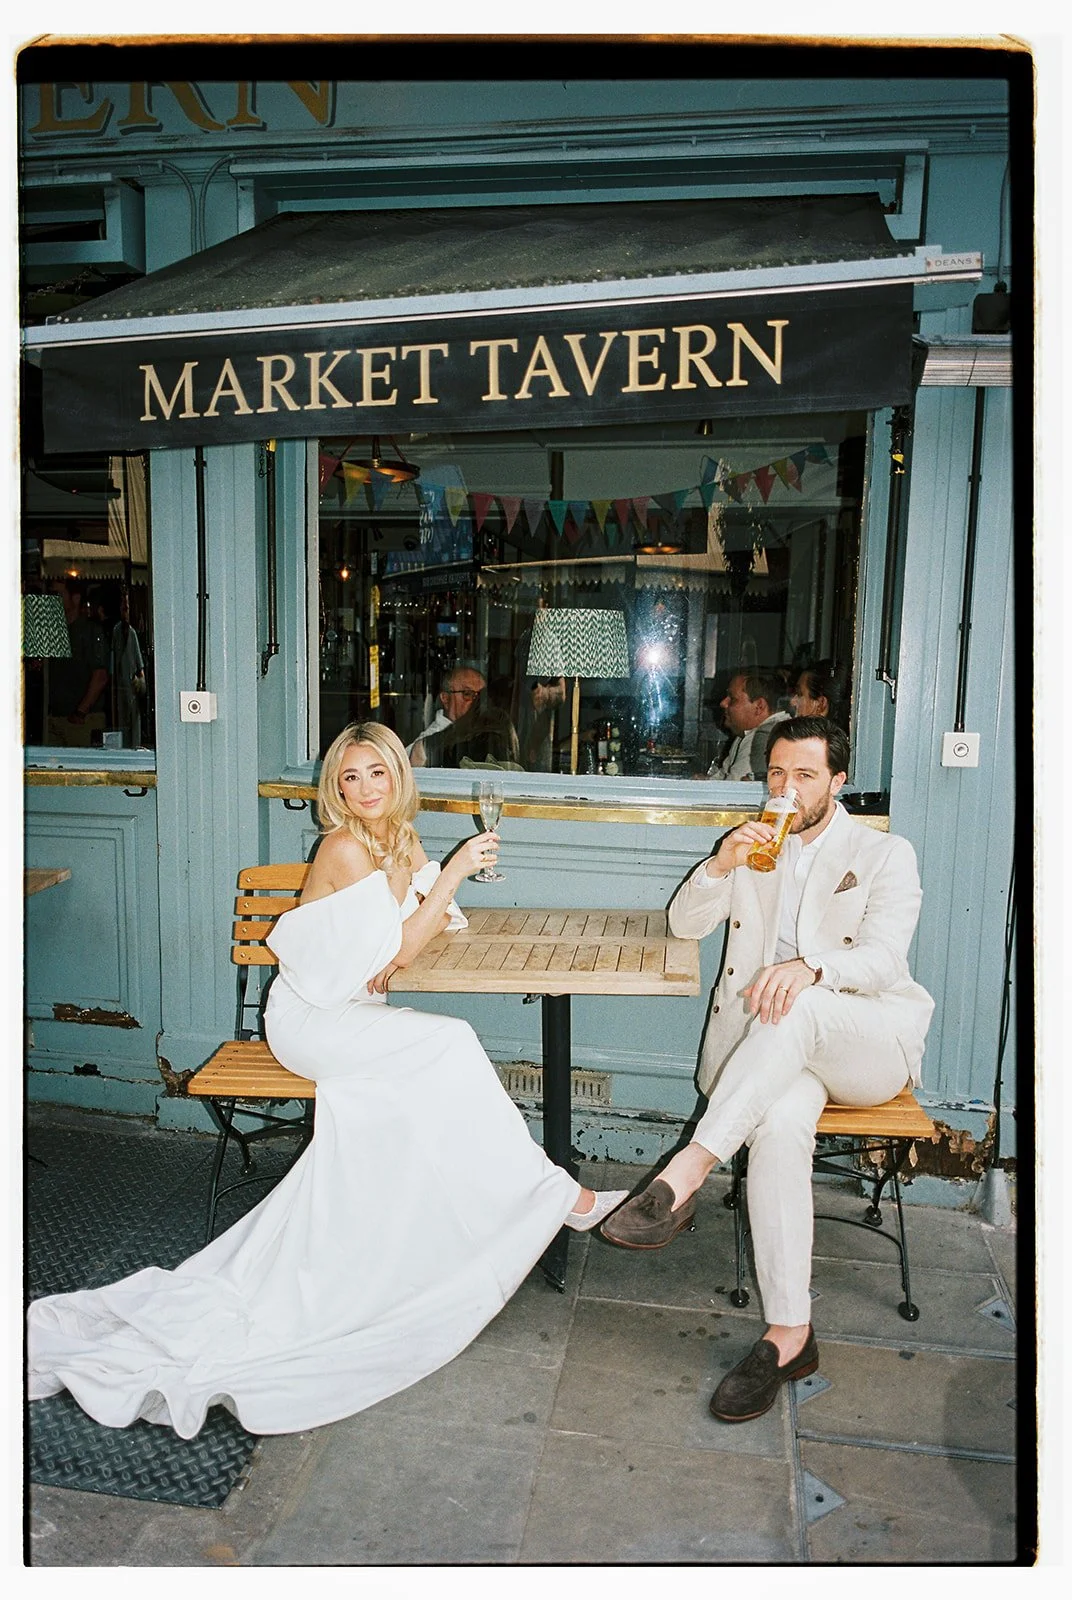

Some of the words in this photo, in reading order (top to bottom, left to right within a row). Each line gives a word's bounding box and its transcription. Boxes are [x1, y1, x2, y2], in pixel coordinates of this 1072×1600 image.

[934, 257, 973, 267] DEANS
[139, 342, 449, 422] MARKET
[469, 319, 790, 402] TAVERN
